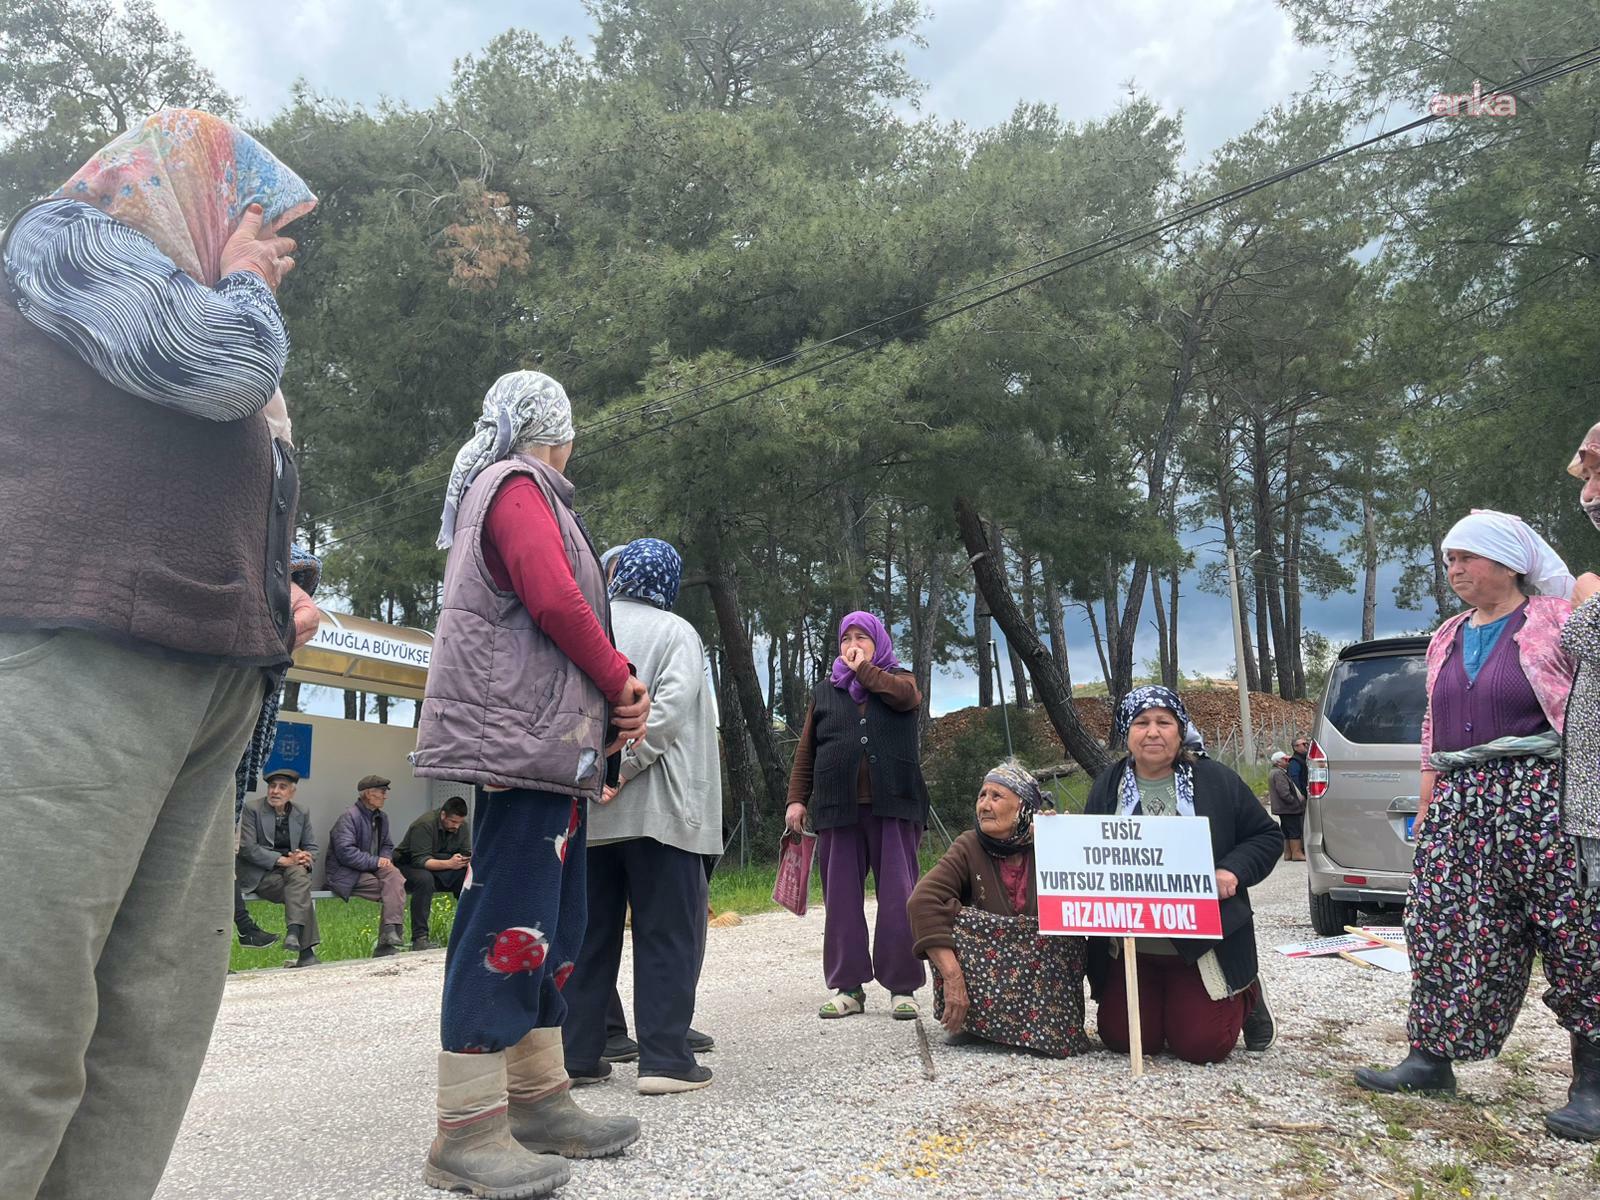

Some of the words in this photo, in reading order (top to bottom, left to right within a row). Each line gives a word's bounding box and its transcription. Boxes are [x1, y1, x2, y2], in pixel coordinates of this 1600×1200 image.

[321, 629, 370, 653] MUĞLA
[373, 640, 430, 664] BÜYÜKŞE
[1101, 819, 1142, 841] EVSİZ
[1083, 846, 1164, 867] TOPRAKSIZ
[1040, 871, 1105, 891] YURTSUZ
[1109, 872, 1213, 894] BIRAKILMAYA
[1061, 901, 1145, 929] RIZAMIZ
[1149, 903, 1198, 930] YOK!
